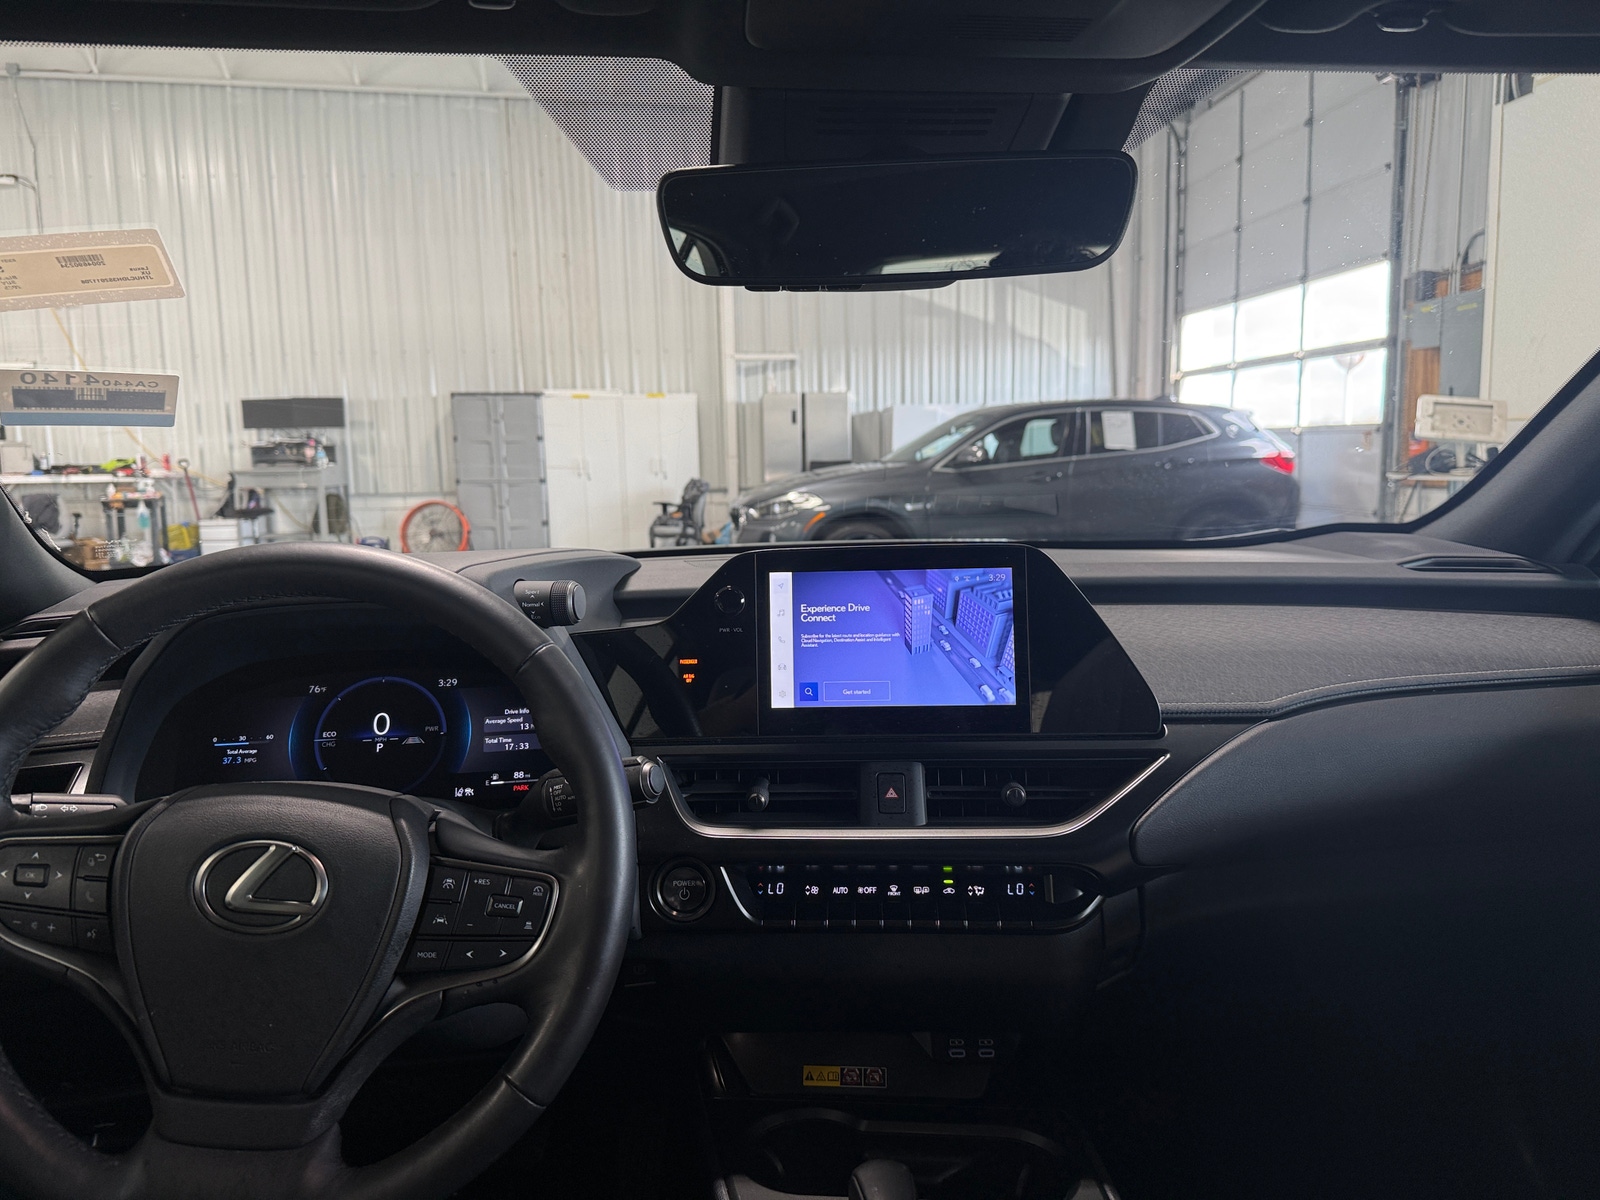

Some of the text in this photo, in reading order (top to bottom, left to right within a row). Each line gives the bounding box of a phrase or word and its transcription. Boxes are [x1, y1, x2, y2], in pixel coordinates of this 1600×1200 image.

[988, 573, 1006, 582] 3:29
[800, 603, 871, 614] Experience Drive
[800, 613, 836, 622] Connect
[438, 678, 458, 687] 3:29
[373, 712, 390, 736] 0
[485, 716, 523, 725] Average Speed
[520, 722, 530, 730] 13
[376, 743, 384, 753] P
[222, 756, 242, 764] 37.3
[513, 771, 525, 779] 88
[672, 880, 696, 888] POWER
[768, 883, 784, 895] LO
[833, 886, 848, 894] AUTO
[864, 886, 877, 894] OFF
[1007, 883, 1024, 895] LO
[494, 902, 516, 910] CANCEL
